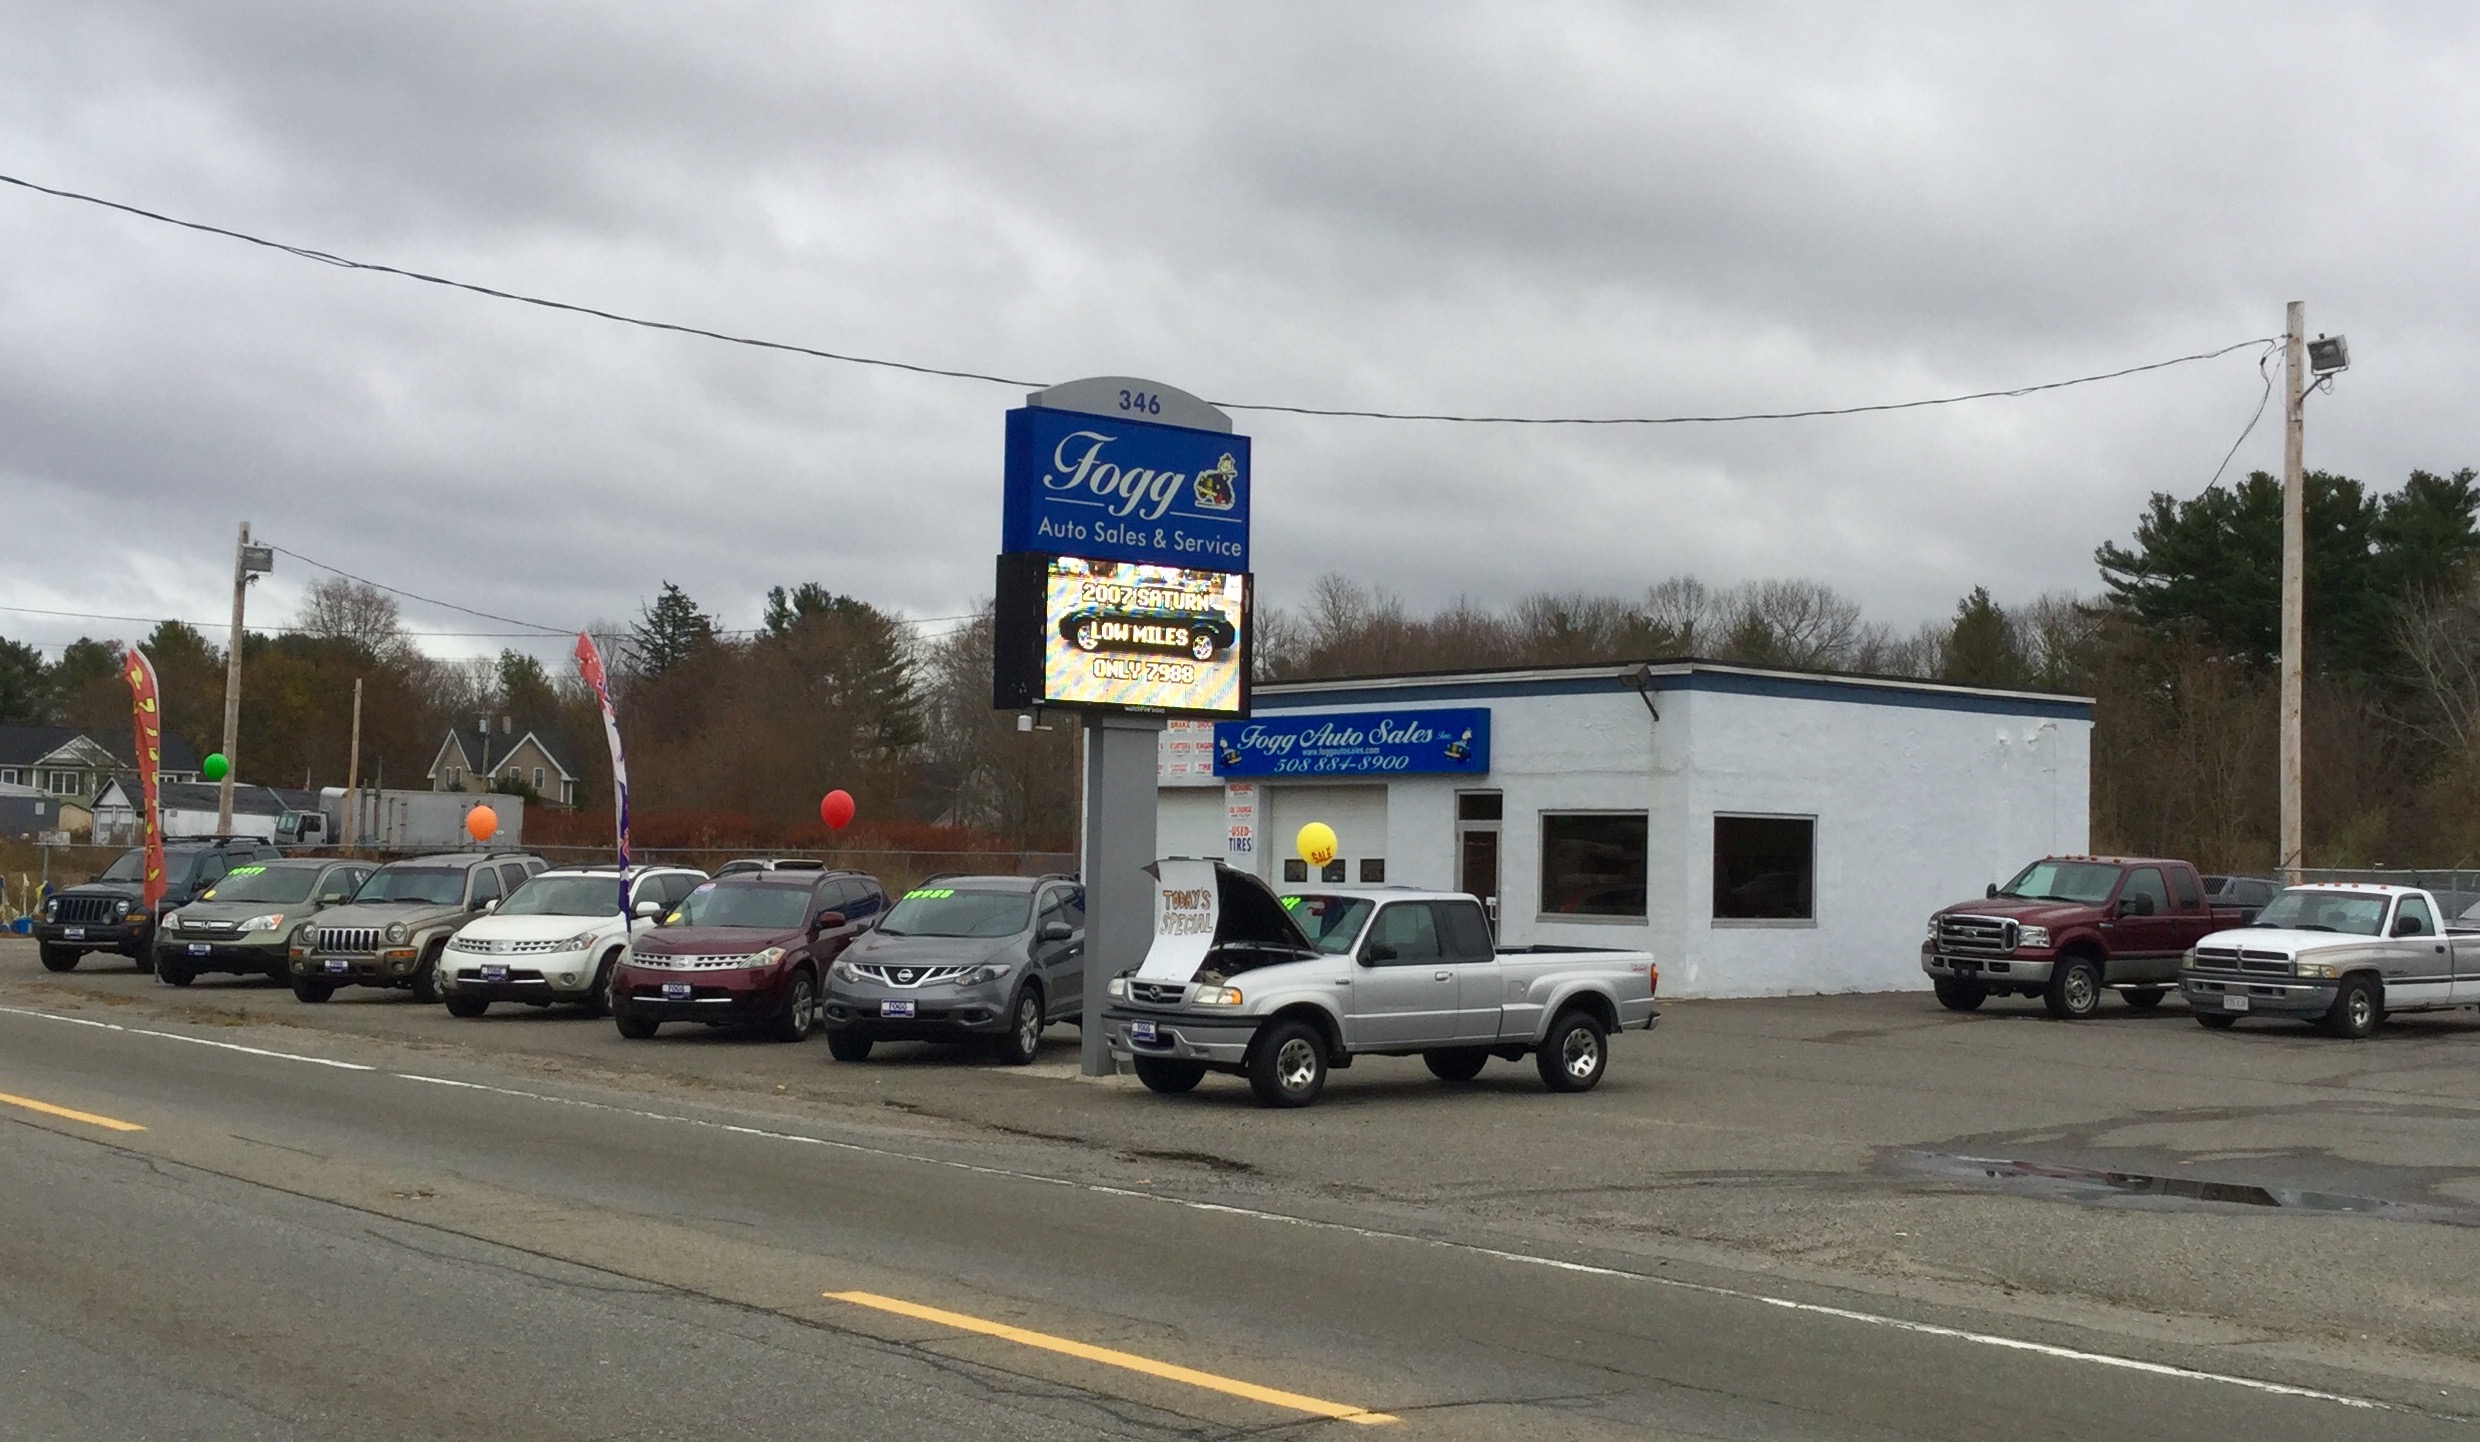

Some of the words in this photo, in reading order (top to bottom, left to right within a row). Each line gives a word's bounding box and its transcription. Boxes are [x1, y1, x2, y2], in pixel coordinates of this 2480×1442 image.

[1119, 389, 1161, 415] 346
[1043, 431, 1185, 520] Fogg
[1038, 516, 1087, 540] Auto
[1094, 522, 1146, 547] Sales
[1153, 528, 1167, 548] &
[1174, 532, 1242, 557] Service
[1082, 582, 1132, 605] 2007
[1136, 587, 1209, 611] SATURN
[1090, 620, 1130, 641] LOW
[1133, 625, 1188, 646] MILES
[1093, 658, 1141, 680] ONLY
[1146, 661, 1195, 684] 7988
[1237, 725, 1297, 756] Fogg
[1300, 722, 1363, 748] Auto
[1368, 719, 1433, 745] Sales
[1274, 757, 1311, 772] 508
[1313, 755, 1409, 772] 884-8900
[1228, 837, 1252, 852] TIRES
[1311, 846, 1333, 864] SALE
[1162, 887, 1211, 911] TODAY'S
[1159, 911, 1213, 936] SPECIAL
